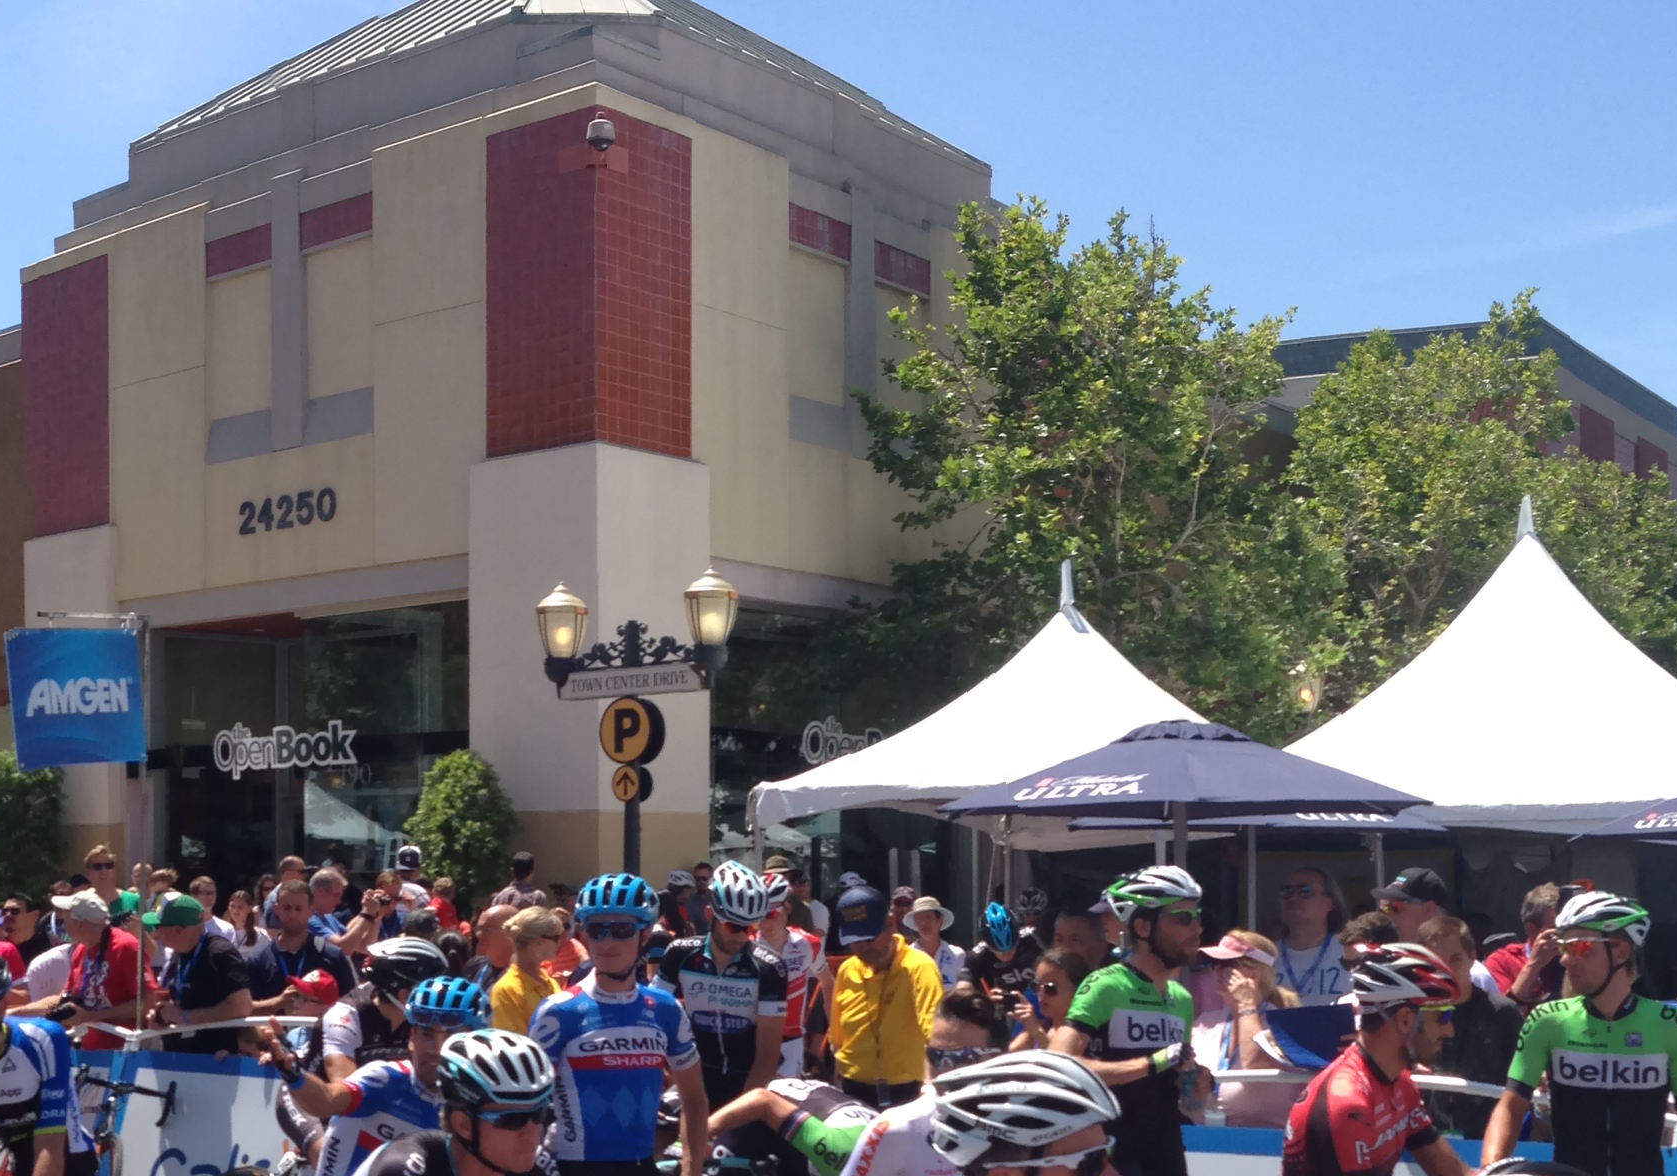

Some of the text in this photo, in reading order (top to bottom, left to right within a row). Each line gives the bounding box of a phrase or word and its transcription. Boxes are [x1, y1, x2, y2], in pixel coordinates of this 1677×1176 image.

[239, 487, 337, 535] 24250
[571, 669, 688, 693] TOWN CENTER DRIVE
[26, 678, 130, 716] AMGEN
[614, 708, 640, 753] P
[578, 1036, 666, 1053] GARMIN
[603, 1055, 662, 1067] SHARP
[1558, 1055, 1660, 1085] belkin
[975, 1119, 1017, 1141] BMC
